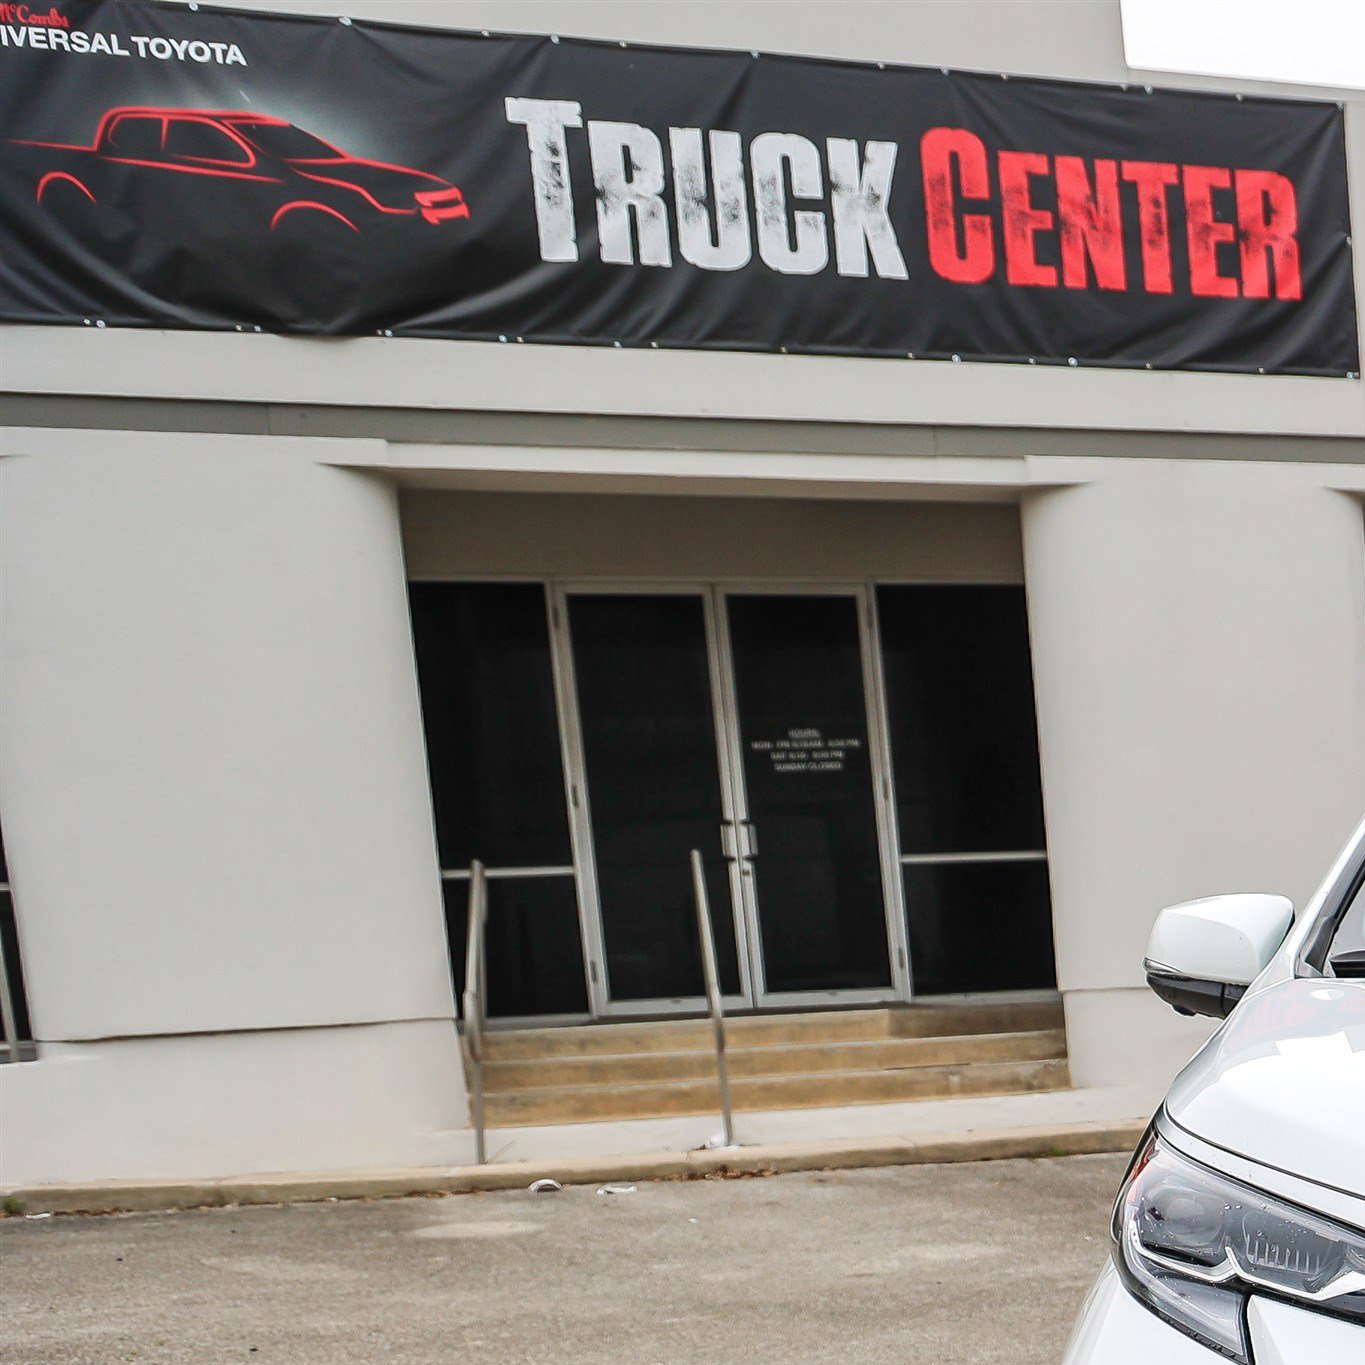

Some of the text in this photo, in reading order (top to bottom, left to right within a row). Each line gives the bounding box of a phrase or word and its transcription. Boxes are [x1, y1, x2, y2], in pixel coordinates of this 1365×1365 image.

[131, 36, 248, 66] TOYOTA
[505, 96, 1302, 300] TRUCK CENTER
